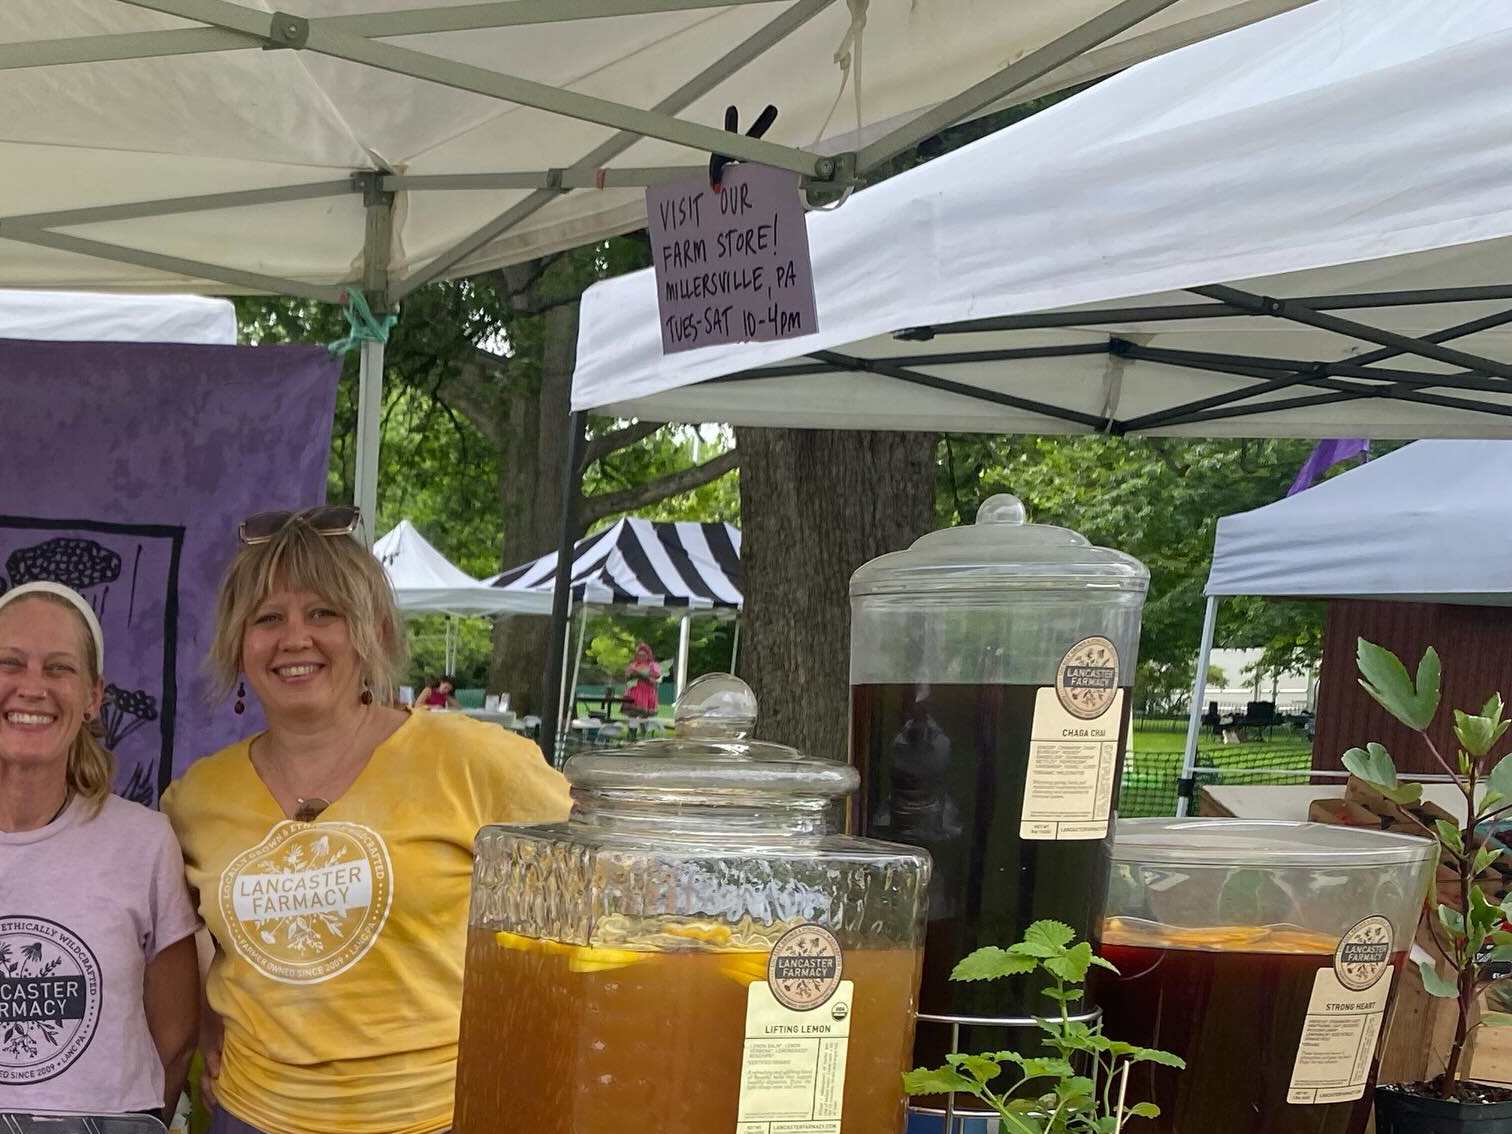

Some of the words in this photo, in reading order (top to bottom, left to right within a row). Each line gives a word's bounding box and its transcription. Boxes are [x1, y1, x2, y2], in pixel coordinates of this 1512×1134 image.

[659, 191, 704, 231] VISIT
[720, 183, 752, 216] OUR
[662, 239, 707, 273] FARM
[716, 213, 778, 258] STORE!
[665, 266, 772, 301] MILLERSVILLE,
[777, 260, 797, 289] PA
[665, 305, 734, 343] TUES-SAT
[1066, 667, 1113, 679] LANCASTER
[1070, 676, 1111, 687] FARMACY
[1062, 728, 1089, 737] CHAGA
[1090, 728, 1106, 737] CHAI
[240, 866, 362, 897] LANCASTER
[251, 886, 350, 914] FARMACY
[1344, 945, 1389, 954] LANCASTER
[0, 921, 58, 937] ETHICALLY
[59, 932, 98, 996] WILDCRAFTED
[778, 957, 834, 969] LANCASTER
[1347, 953, 1383, 962] FARMACY
[782, 967, 828, 978] FARMACY
[1325, 1003, 1355, 1012] STRONG
[1356, 1001, 1377, 1011] HEART
[764, 1024, 799, 1034] LIFTING
[801, 1023, 832, 1034] LEMON
[10, 1070, 36, 1079] SINCE
